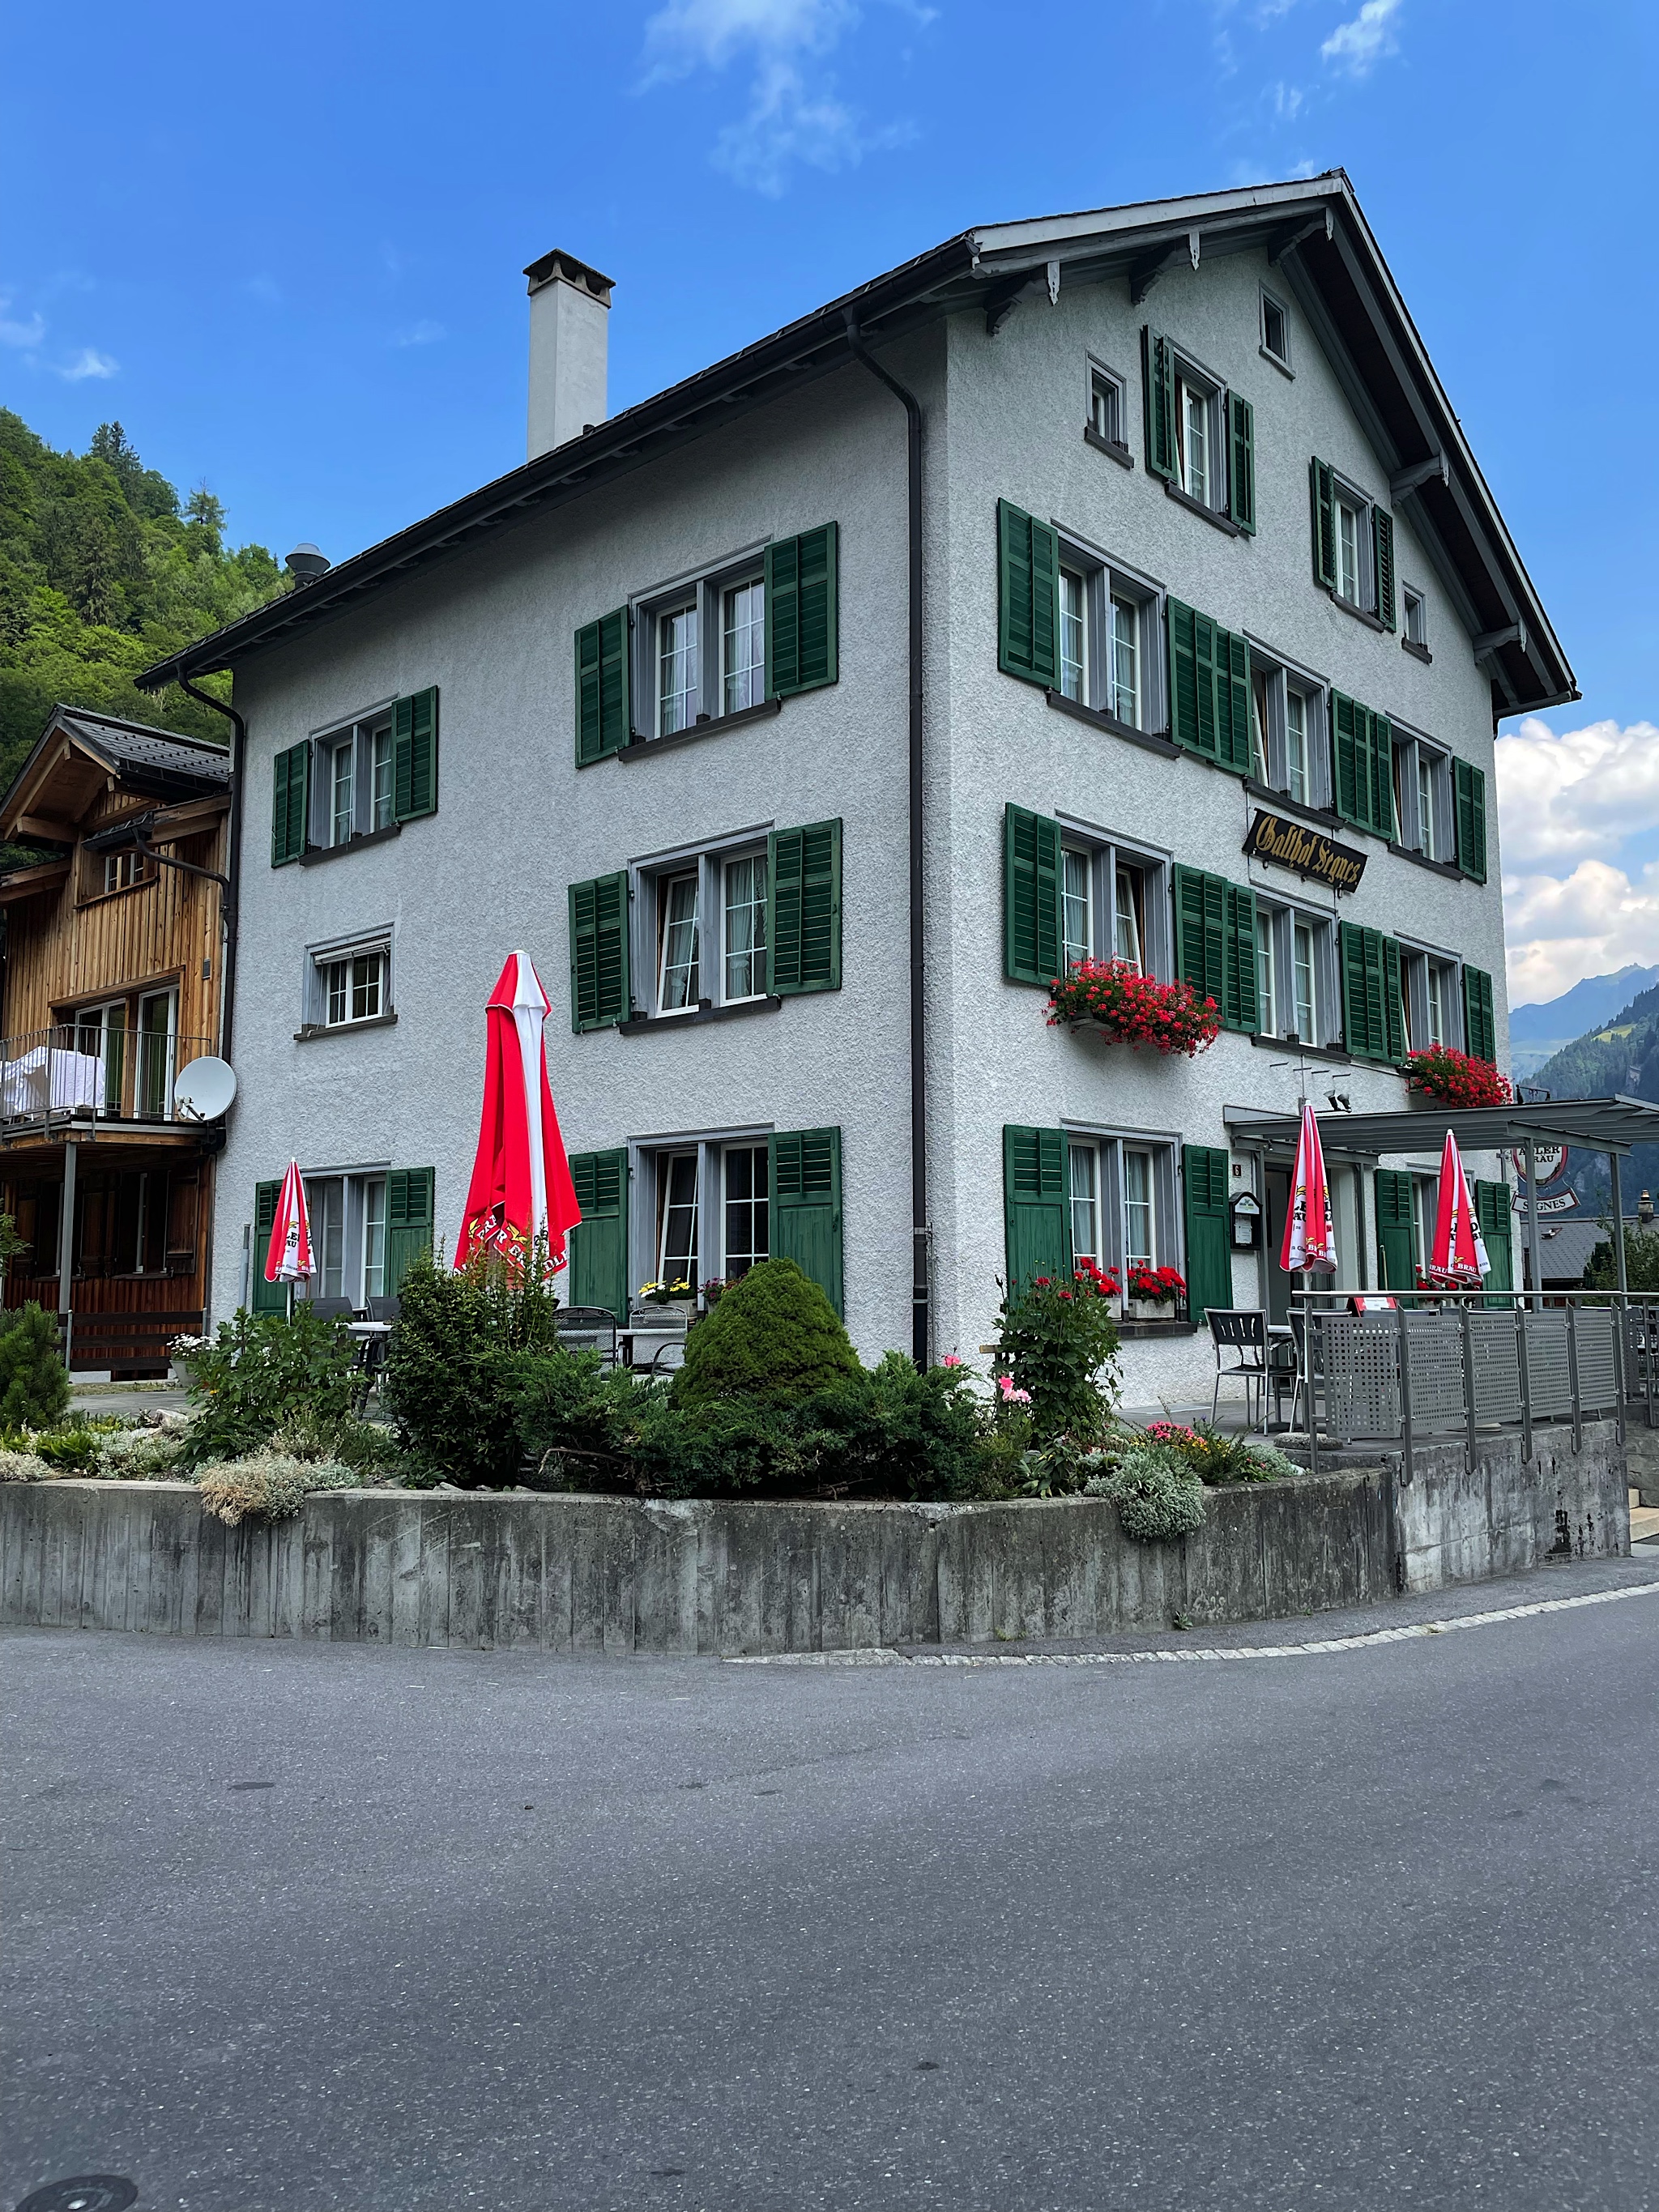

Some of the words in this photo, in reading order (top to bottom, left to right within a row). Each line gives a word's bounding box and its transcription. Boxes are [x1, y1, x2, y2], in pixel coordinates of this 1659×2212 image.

[1518, 1146, 1560, 1156] ALER
[1533, 1153, 1555, 1163] RÄU
[1235, 1165, 1240, 1176] 6
[1522, 1198, 1566, 1211] SGNES
